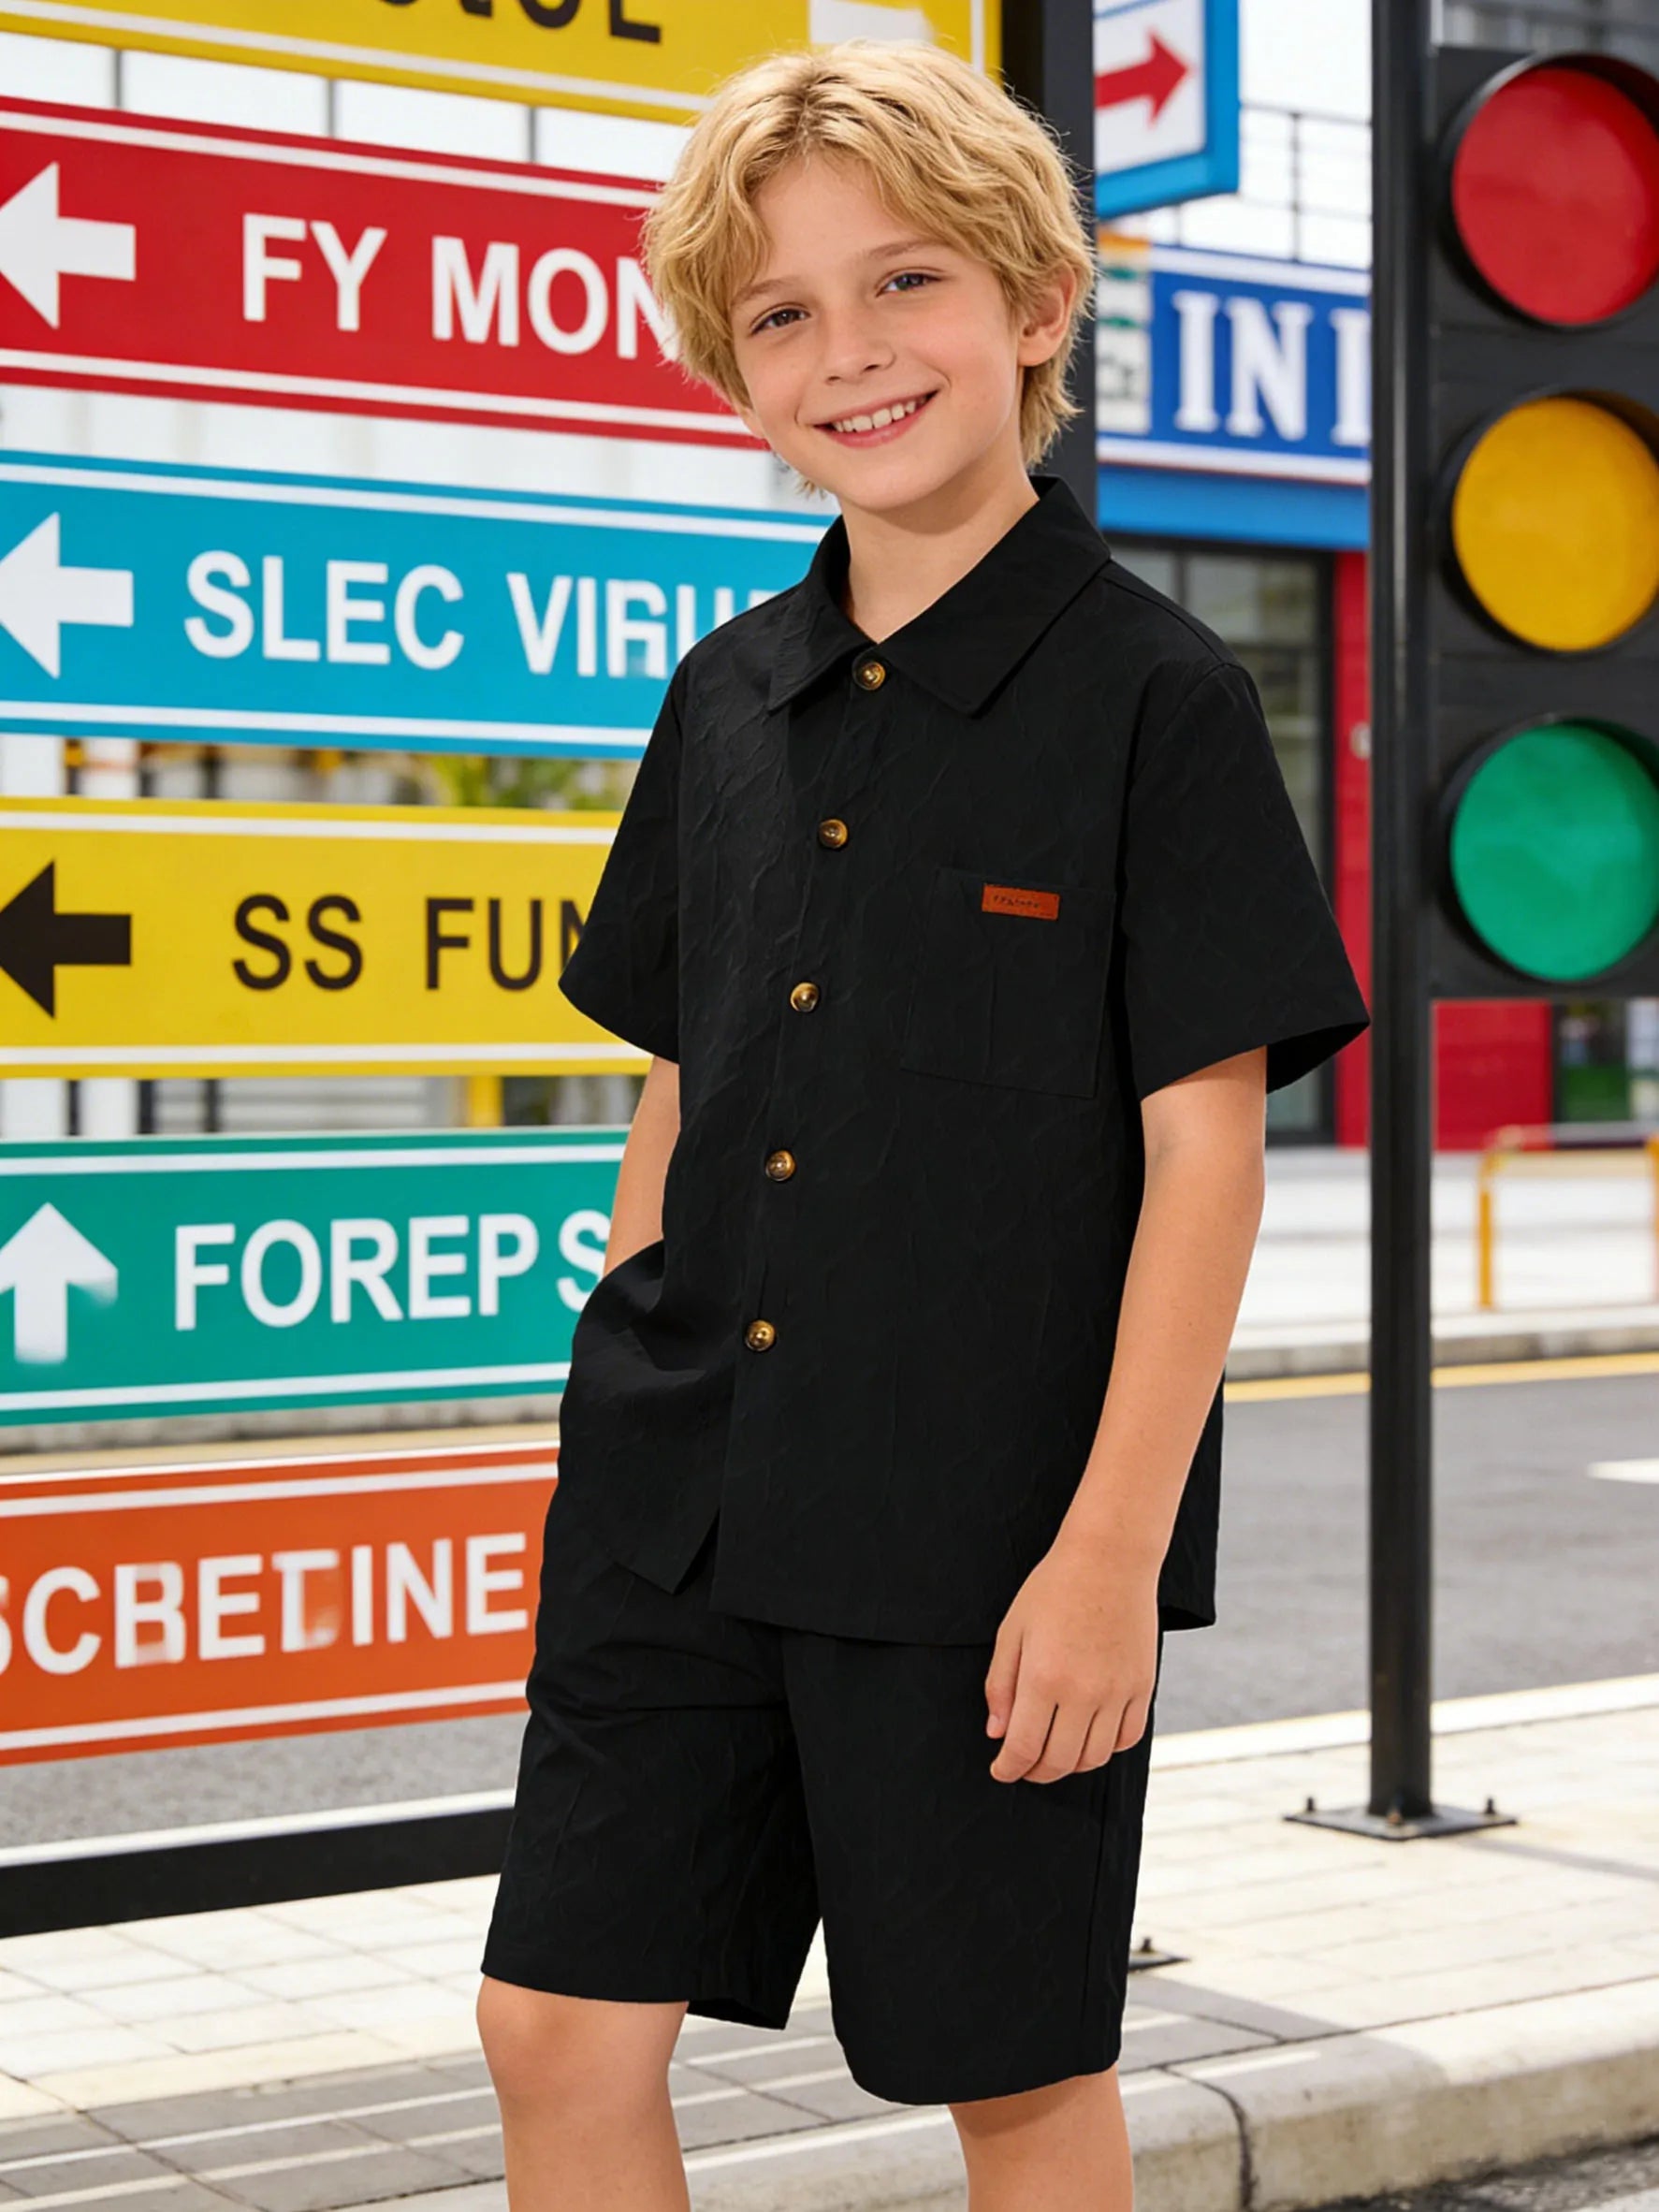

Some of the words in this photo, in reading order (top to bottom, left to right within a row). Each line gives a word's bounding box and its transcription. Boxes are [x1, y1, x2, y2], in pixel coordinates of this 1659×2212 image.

[242, 212, 387, 332] FY
[184, 550, 465, 671] SLEC
[232, 893, 364, 992] SS
